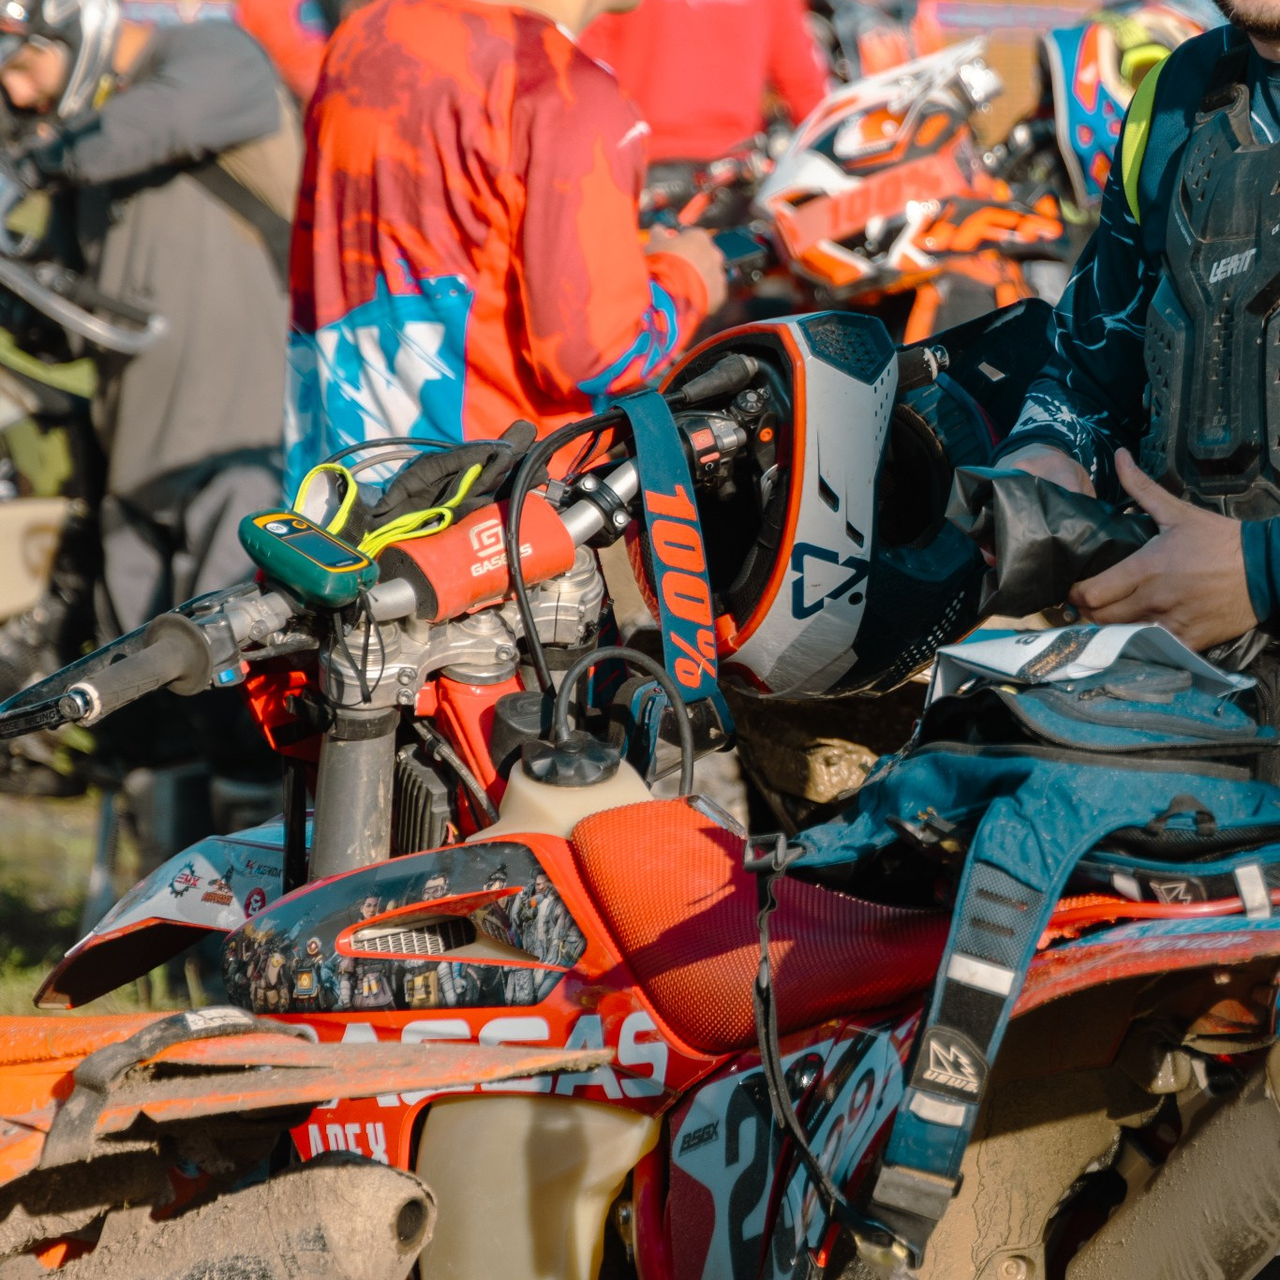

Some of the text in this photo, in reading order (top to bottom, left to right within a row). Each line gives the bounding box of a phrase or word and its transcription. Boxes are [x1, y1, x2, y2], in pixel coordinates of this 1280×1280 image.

[1209, 248, 1257, 284] LEATT
[470, 542, 533, 577] GASGS
[644, 483, 717, 689] 100%
